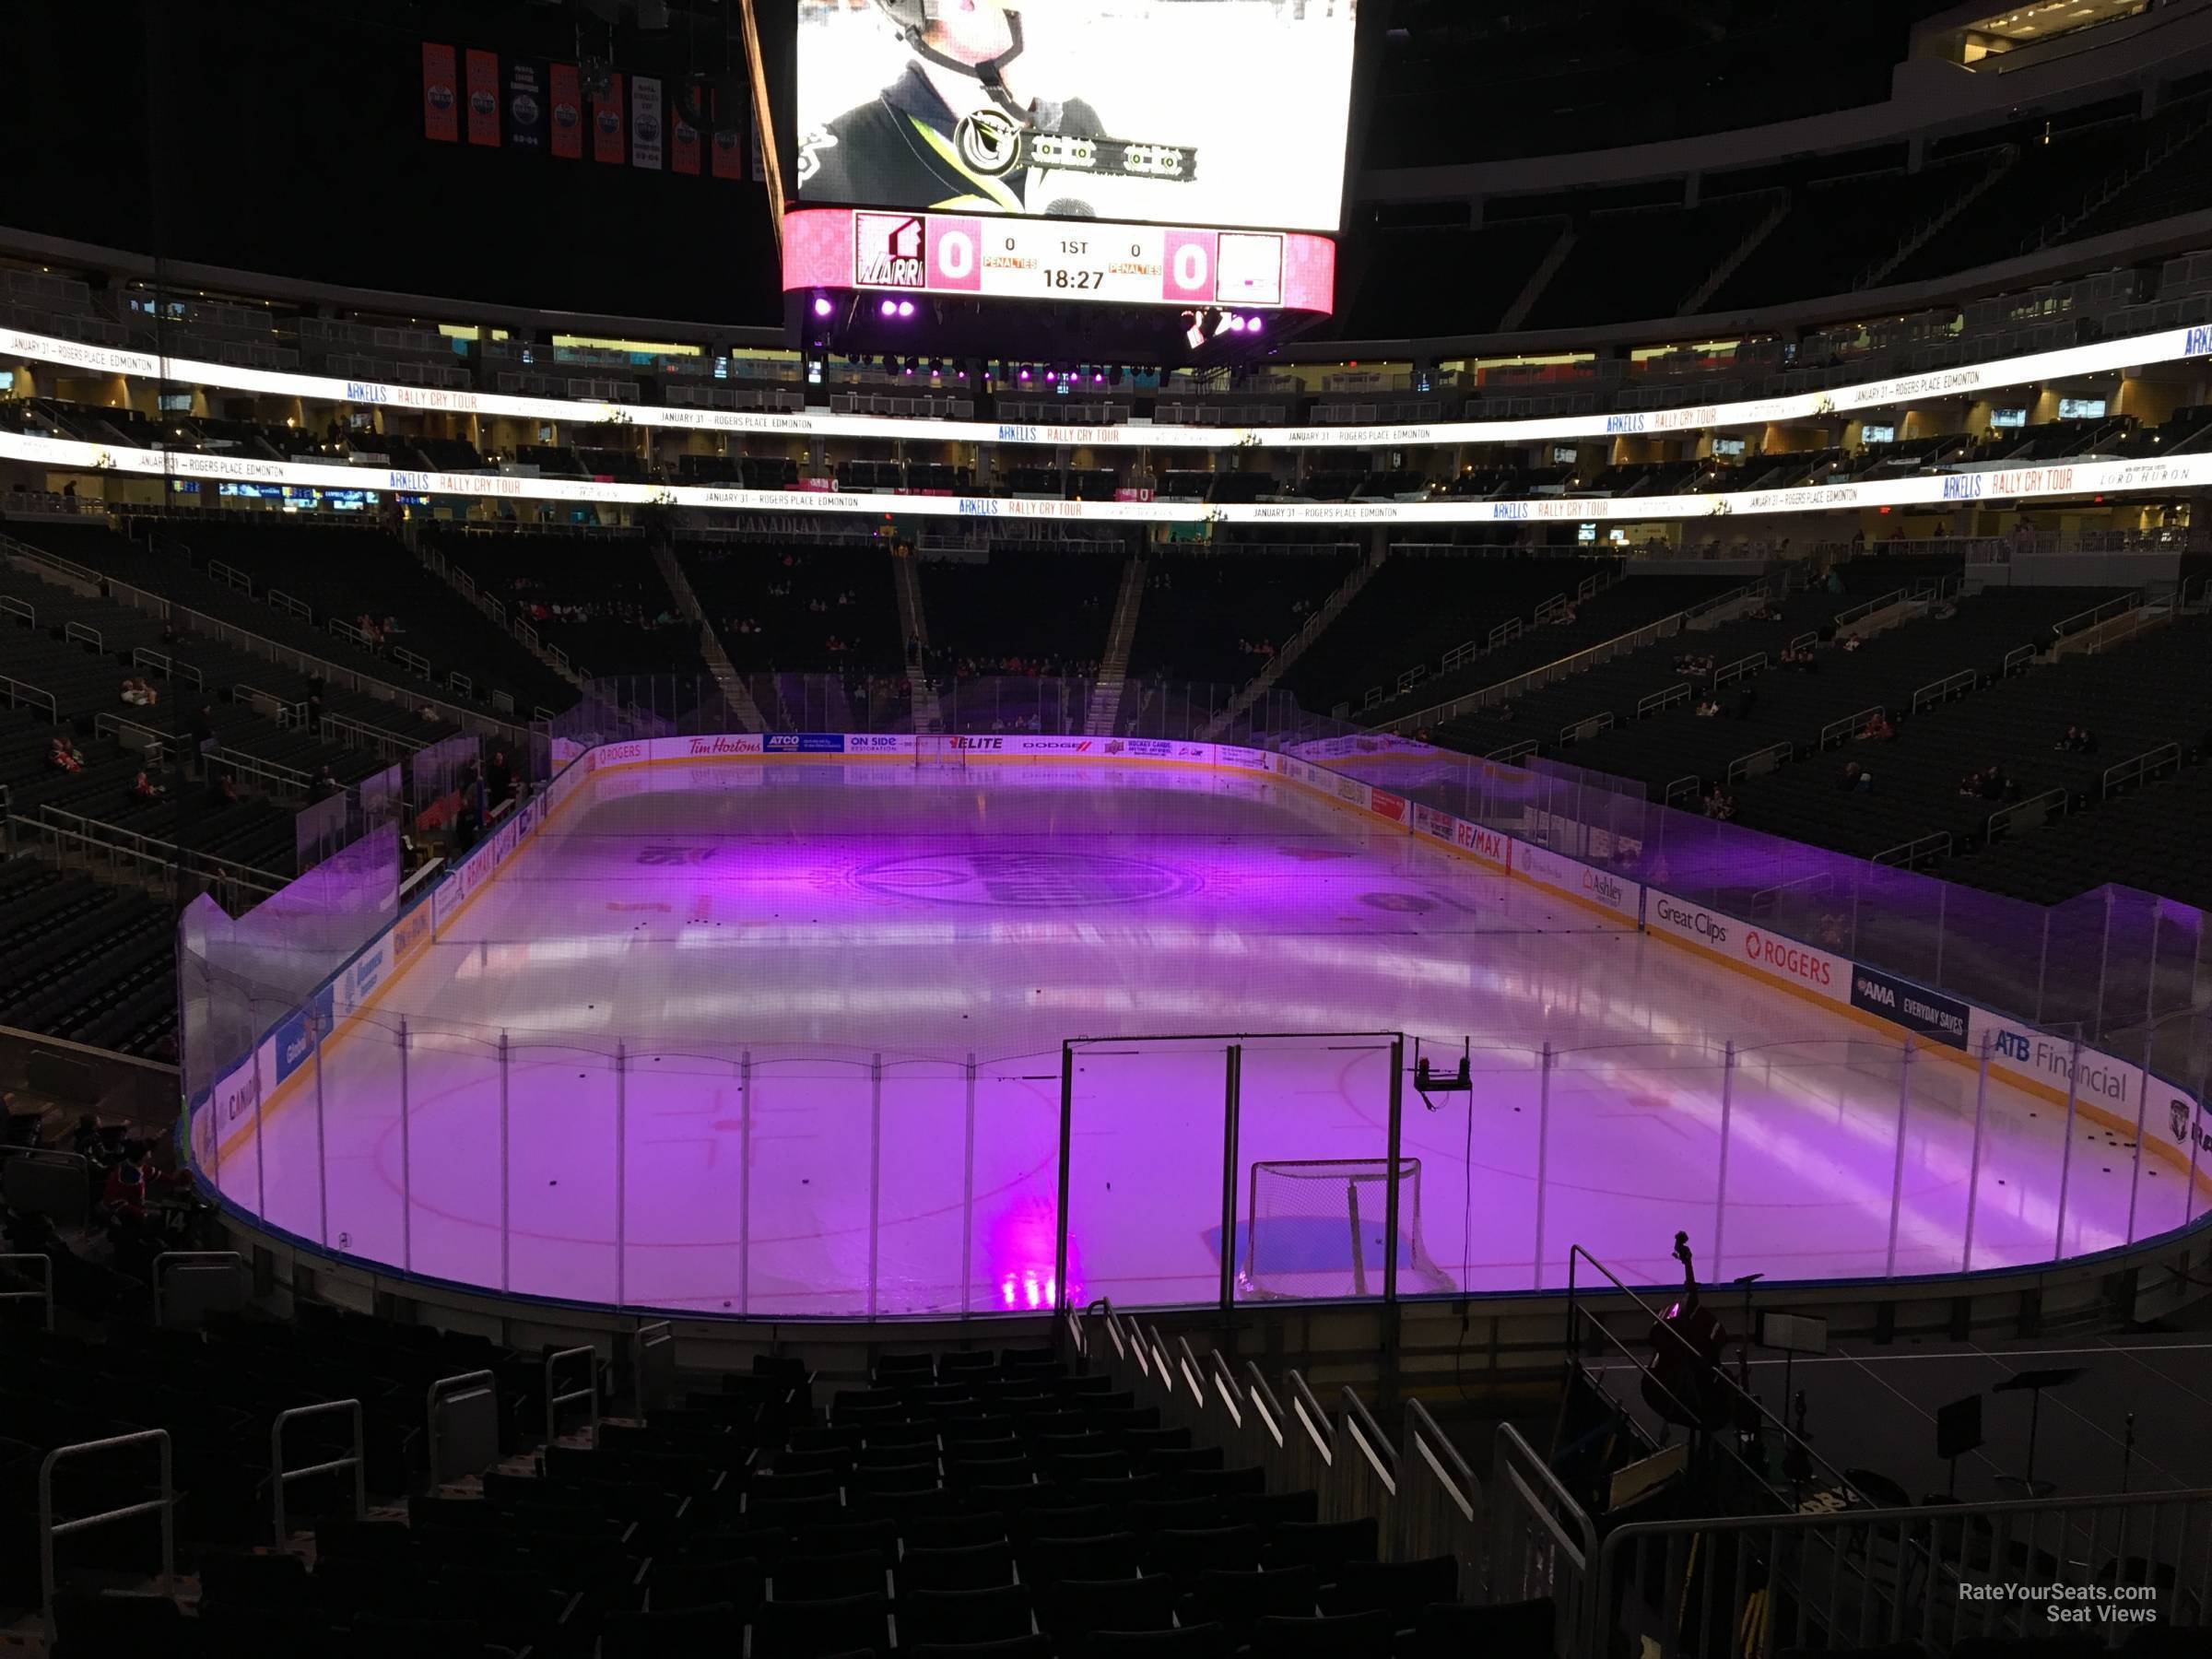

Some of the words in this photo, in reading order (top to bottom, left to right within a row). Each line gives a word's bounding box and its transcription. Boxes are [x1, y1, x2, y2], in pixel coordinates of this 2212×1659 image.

[1006, 238, 1015, 250] 0
[1061, 241, 1088, 254] 1ST
[1132, 244, 1140, 256] 0
[938, 230, 973, 278] 0
[983, 256, 1038, 269] PENALTIES
[1109, 264, 1161, 276] PENALTIES
[1172, 243, 1207, 290] 0
[1044, 270, 1103, 288] 18:27
[11, 337, 40, 351] JANUARY
[58, 345, 83, 361] ROGERS
[85, 350, 105, 365] PLACE
[111, 356, 152, 371] EDMONTON
[347, 382, 386, 402] ARKELLS
[398, 389, 425, 406] RALLY
[430, 392, 448, 406] CRY
[453, 394, 477, 408] TOUR
[1854, 387, 1879, 403] JANUARY
[1896, 381, 1919, 395] ROGERS
[1921, 376, 1941, 392] PLACE
[1944, 371, 1980, 388] EDMONTON
[661, 412, 693, 421] JANUARY
[696, 414, 703, 423] 31
[714, 416, 743, 427] ROGERS
[746, 418, 767, 428] PLACE
[772, 418, 812, 429] EDMONTON
[1607, 415, 1644, 432] ARKELLS
[1655, 412, 1677, 429] RALLY
[1680, 411, 1693, 426] CRY
[1697, 407, 1717, 425] TOUR
[999, 426, 1037, 441] ARKELLS
[1048, 429, 1074, 441] RALLY
[1077, 429, 1092, 441] CRY
[1098, 429, 1119, 442] TOUR
[1288, 431, 1319, 441] JANUARY
[1339, 431, 1367, 441] ROGERS
[1370, 430, 1389, 440] PLACE
[1394, 429, 1430, 439] EDMONTON
[190, 459, 218, 472] ROGERS
[221, 461, 241, 474] PLACE
[247, 464, 284, 477] EDMONTON
[2100, 473, 2133, 486] LORD
[2141, 468, 2190, 483] HURON
[390, 472, 429, 490] ARKELLS
[441, 476, 469, 492] RALLY
[475, 478, 491, 493] CRY
[496, 479, 521, 494] TOUR
[1943, 474, 1982, 500] ARKELLS
[1993, 472, 2021, 494] RALLY
[2025, 470, 2043, 492] CRY
[2047, 468, 2073, 490] TOUR
[706, 493, 737, 502] JANUARY
[740, 493, 748, 502] 31
[759, 494, 789, 505] ROGERS
[791, 496, 814, 506] PLACE
[818, 496, 858, 506] EDMONTON
[1785, 493, 1806, 506] ROGERS
[1807, 491, 1823, 504] PLACE
[1827, 488, 1858, 502] EDMONTON
[959, 500, 998, 515] ARKELLS
[1008, 501, 1036, 514] RALLY
[1040, 502, 1055, 515] CRY
[1060, 503, 1082, 516] TOUR
[1253, 508, 1285, 517] JANUARY
[1288, 508, 1295, 517] 31
[1306, 508, 1333, 517] ROGERS
[1335, 509, 1357, 517] PLACE
[1360, 508, 1397, 517] EDMONTON
[1493, 503, 1528, 519] ARKELLS
[1538, 502, 1564, 516] RALLY
[1567, 501, 1582, 516] CRY
[1586, 501, 1608, 516] TOUR
[737, 515, 821, 534] CANADIAN
[690, 738, 711, 754] Tim
[712, 736, 760, 753] Hortons
[769, 736, 799, 745] ATCO
[851, 737, 869, 747] ON
[959, 737, 1003, 748] ELITE
[606, 745, 641, 759] ROGERS
[1458, 824, 1500, 858] RE/MAX
[1594, 876, 1622, 902] Ashley
[1658, 900, 1692, 929] Great
[1695, 913, 1725, 943] Clips
[1765, 941, 1830, 984] ROGERS
[1864, 981, 1895, 1007] AMA
[1903, 998, 1939, 1025] EVERYDAY
[1939, 1012, 1963, 1035] SAVES
[1994, 1030, 2030, 1062] ATB
[2037, 1042, 2126, 1101] Financial
